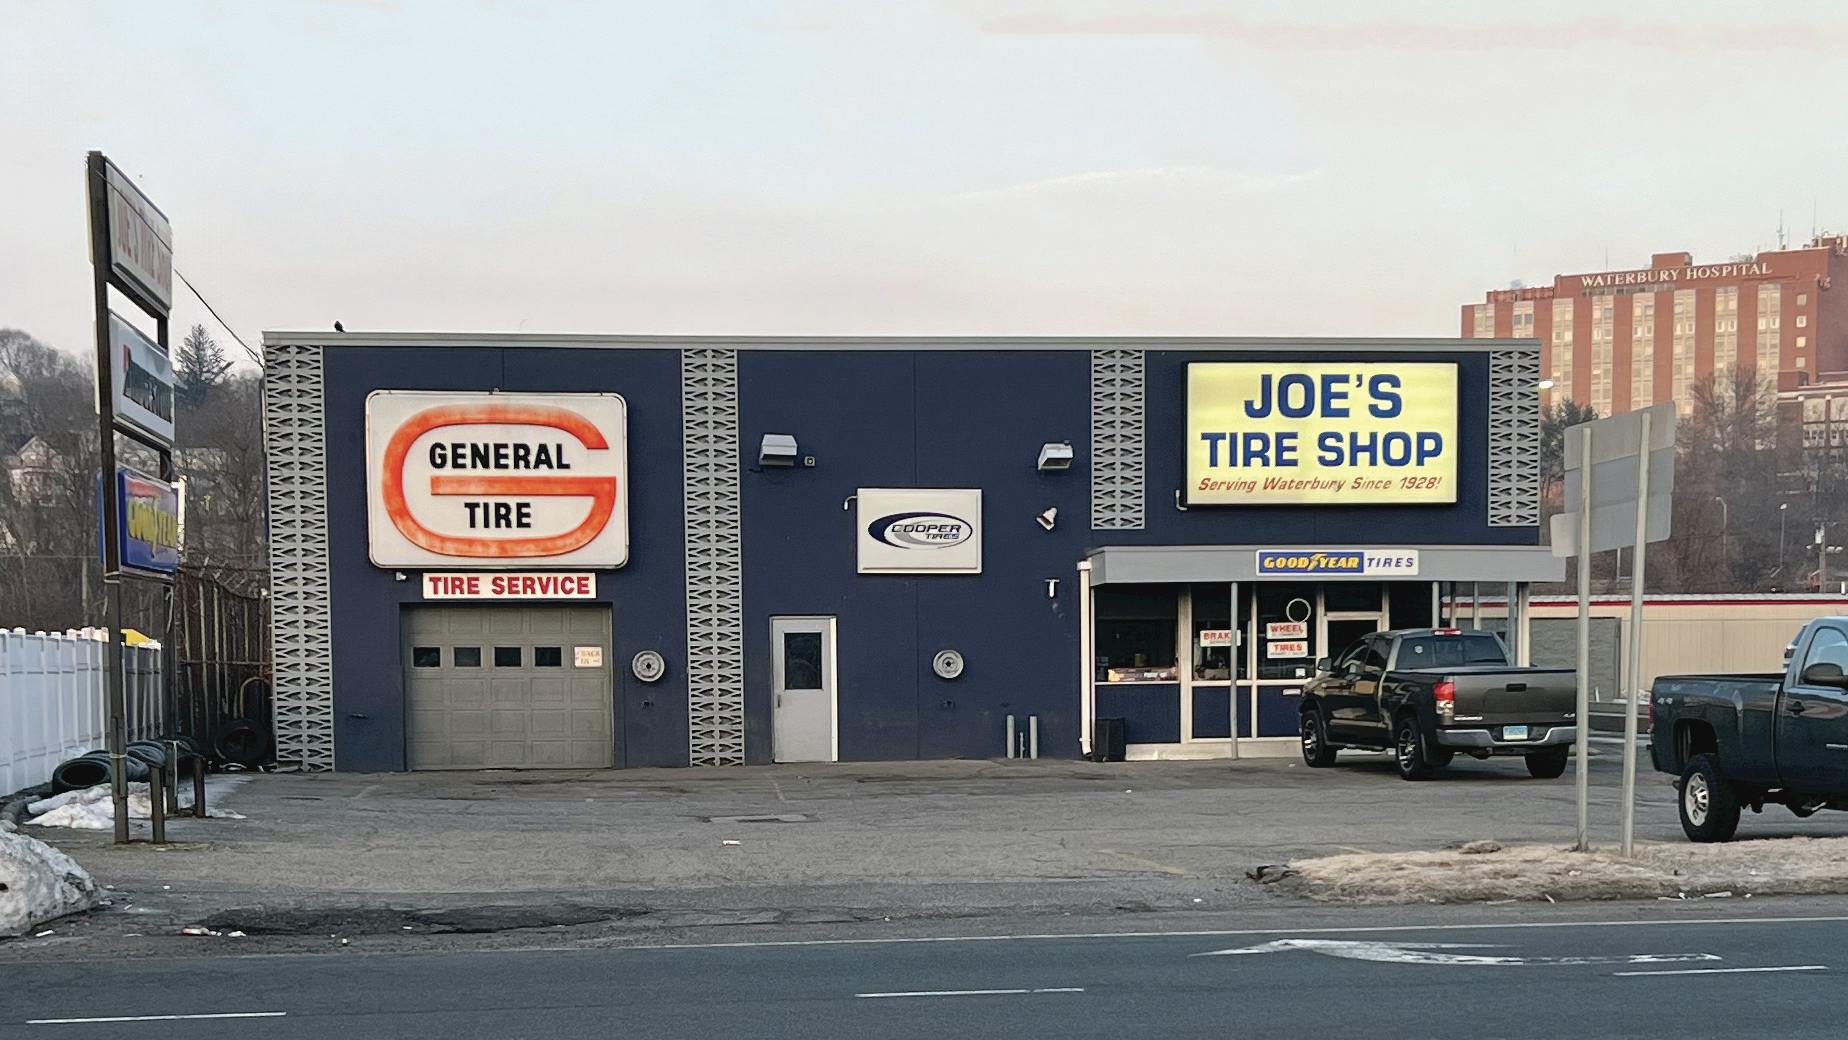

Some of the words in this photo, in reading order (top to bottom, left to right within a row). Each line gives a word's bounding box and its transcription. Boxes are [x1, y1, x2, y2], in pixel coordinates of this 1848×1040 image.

[1581, 269, 1680, 287] WATERBURY
[1686, 263, 1772, 280] HOSPITAL
[1244, 374, 1402, 418] JOE'S
[429, 442, 571, 469] GENERAL
[1200, 431, 1299, 467] TIRE
[1317, 431, 1443, 466] SHOP
[1199, 477, 1258, 492] Serving
[1263, 476, 1346, 492] Waterbury
[1351, 477, 1392, 490] Since
[1400, 476, 1442, 489] 1928!
[464, 502, 531, 528] TIRE
[891, 524, 961, 533] COOPER
[1263, 555, 1360, 570] GOODYEAR
[1367, 557, 1414, 568] TIRES
[429, 576, 480, 594] TIRE
[491, 576, 590, 594] SERVICE
[1203, 632, 1232, 641] BRAK
[1270, 624, 1304, 633] WHEEL
[1274, 643, 1303, 652] TIRES
